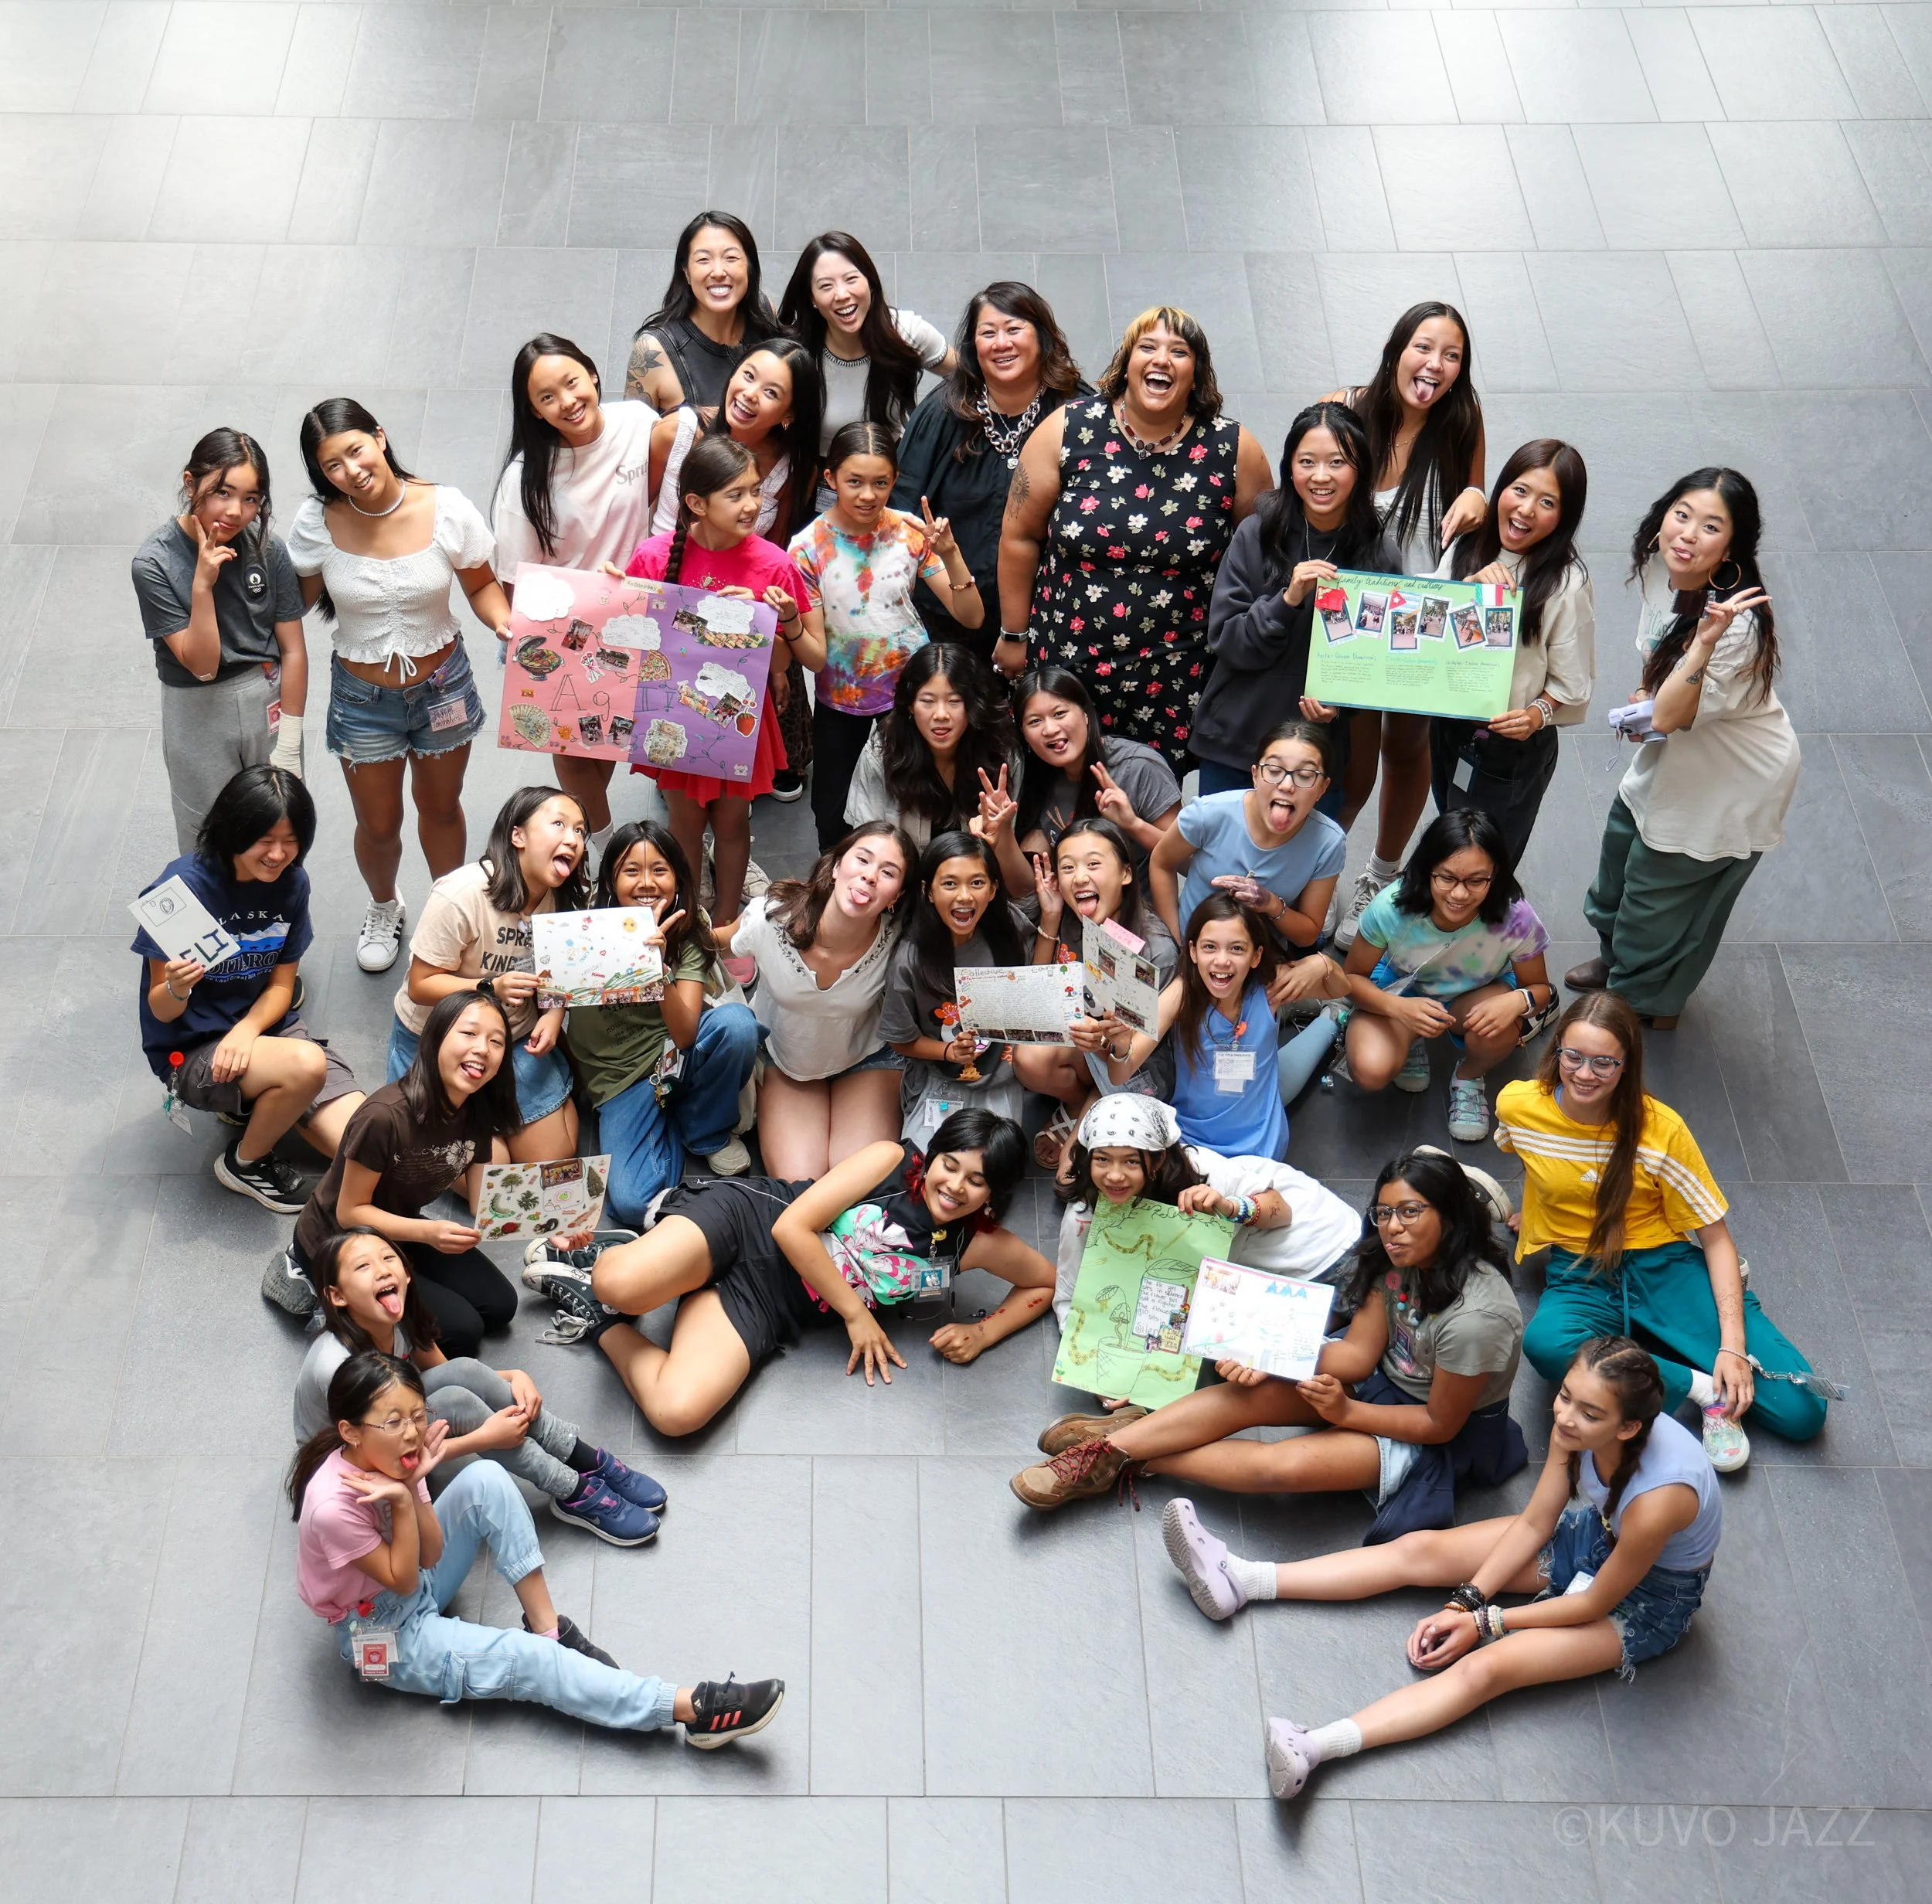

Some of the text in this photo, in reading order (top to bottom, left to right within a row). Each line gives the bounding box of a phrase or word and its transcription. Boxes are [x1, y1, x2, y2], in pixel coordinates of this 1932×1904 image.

[1336, 574, 1362, 590] family
[219, 910, 284, 926] LASKA
[496, 926, 534, 949] SPRE
[207, 950, 282, 974] DITARO
[479, 950, 523, 973] KIND
[961, 967, 1005, 978] Collective
[1135, 1321, 1159, 1335] Silen
